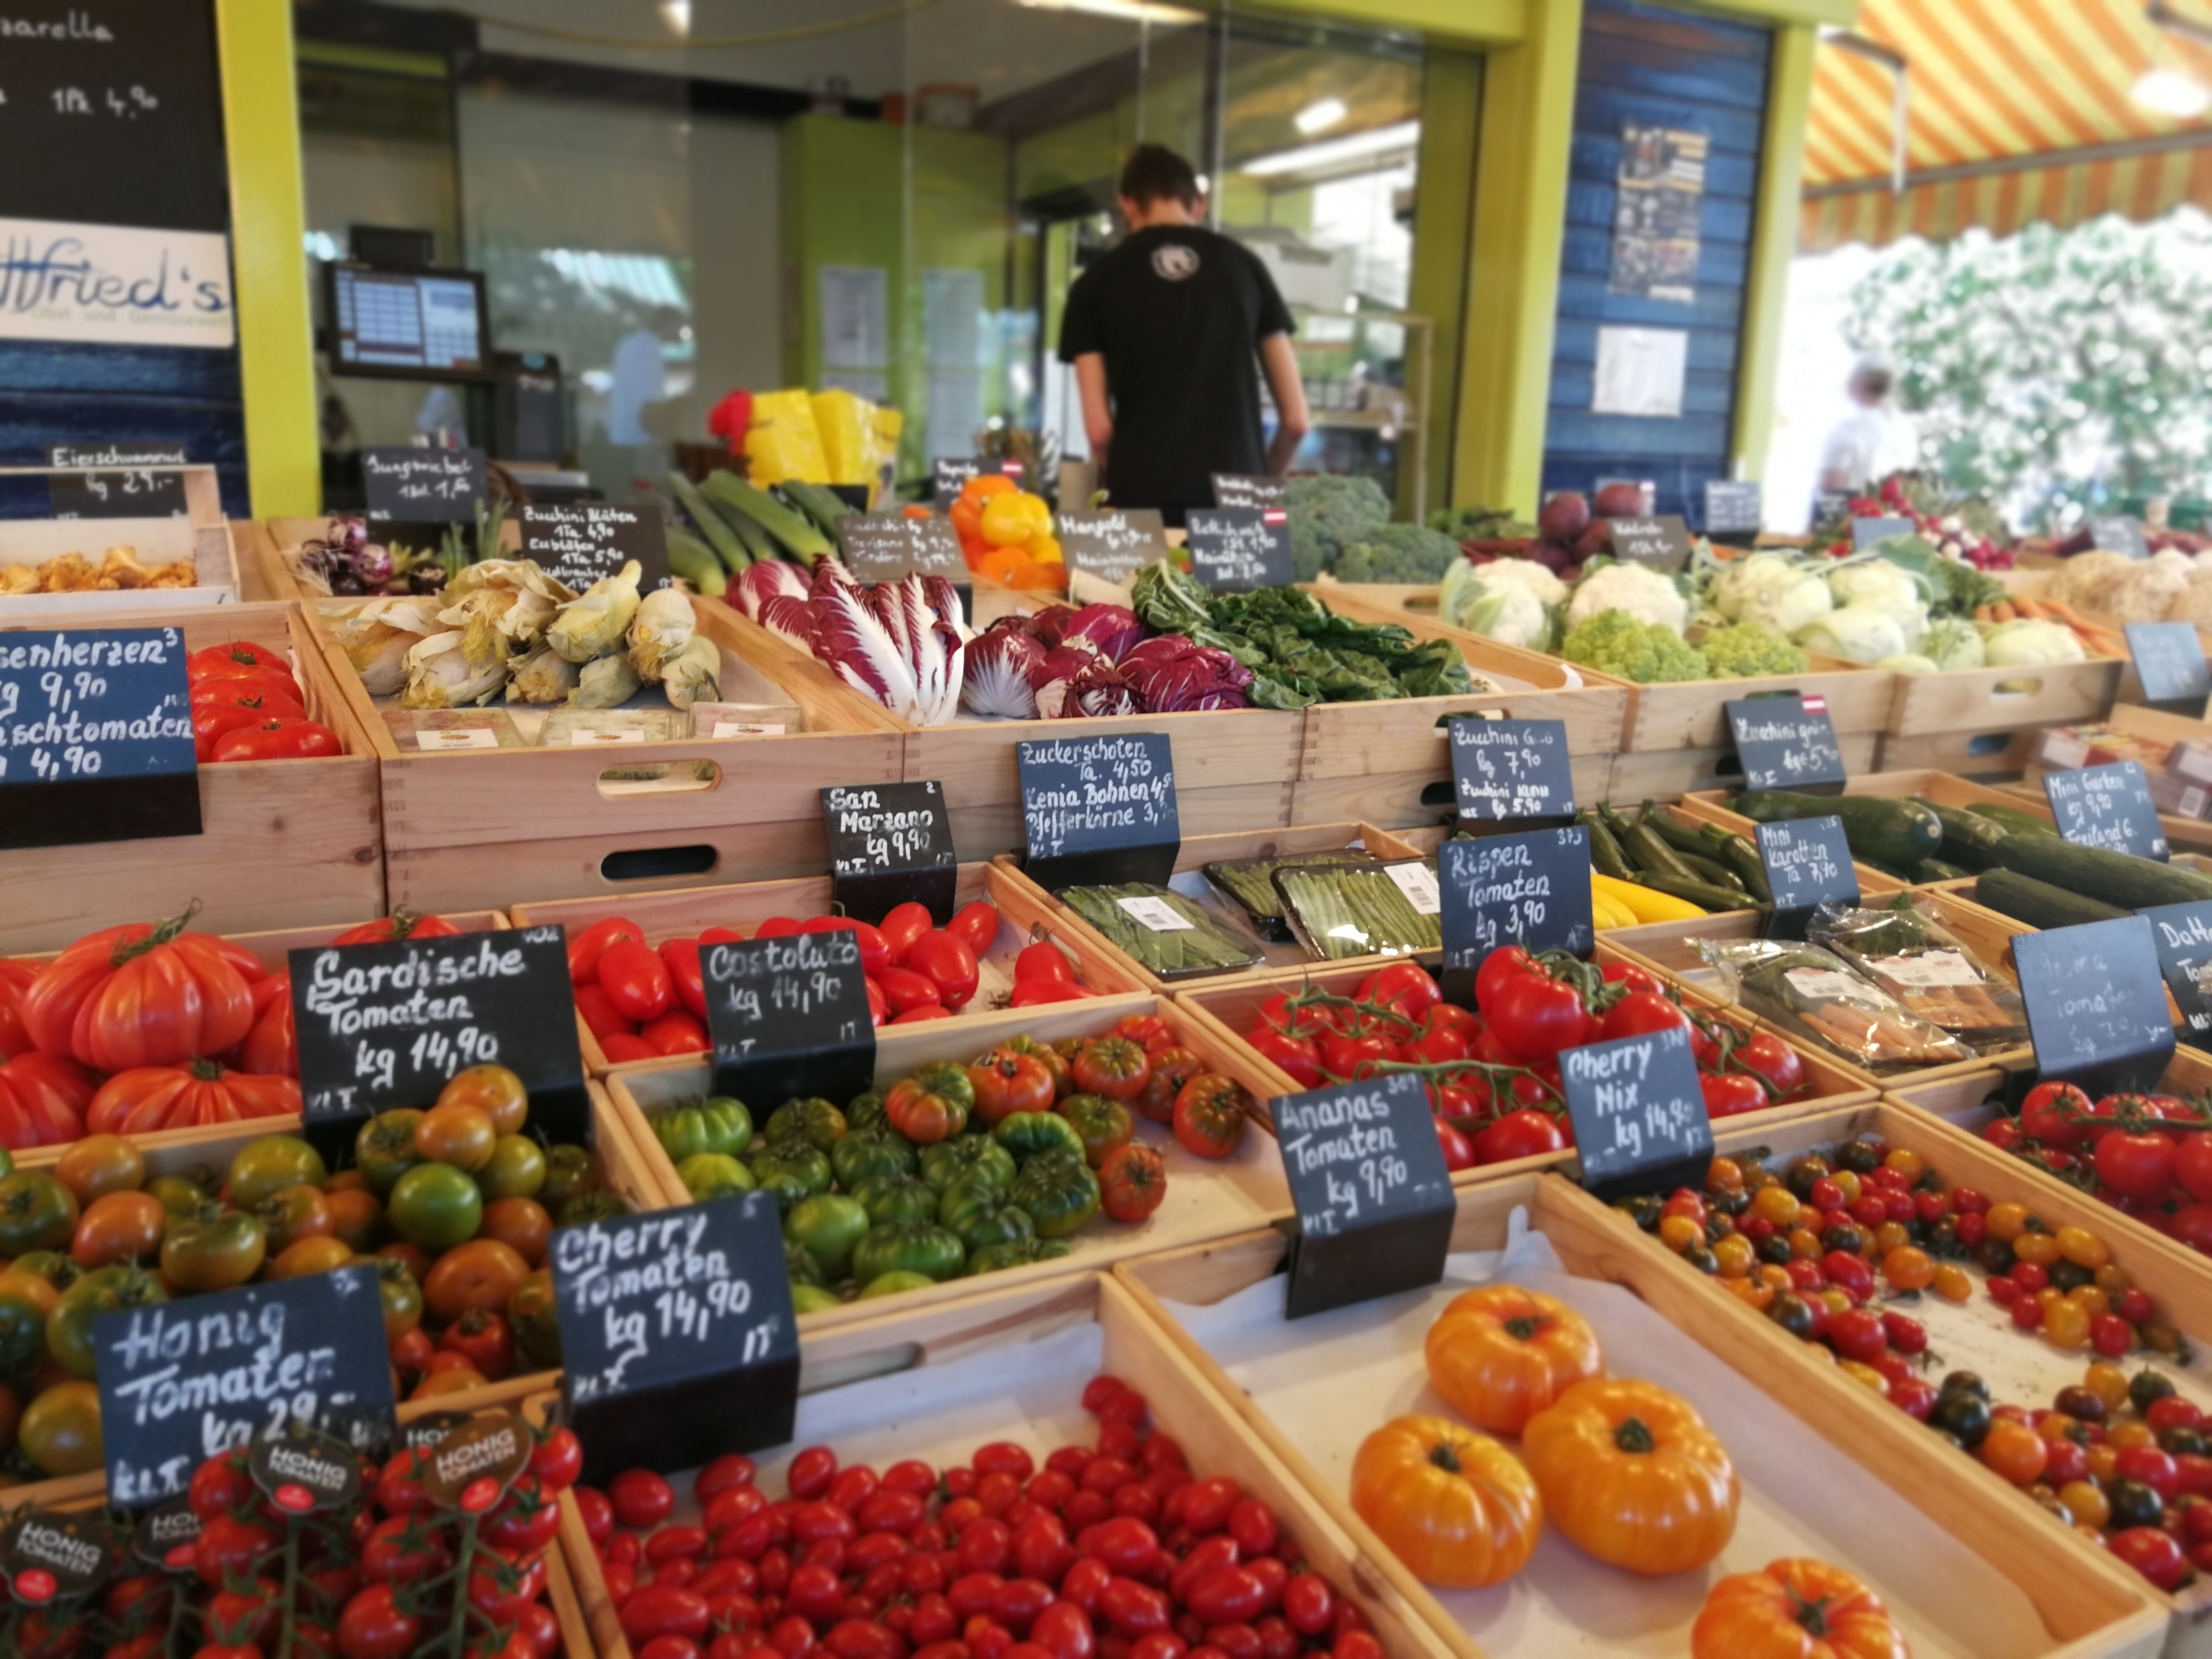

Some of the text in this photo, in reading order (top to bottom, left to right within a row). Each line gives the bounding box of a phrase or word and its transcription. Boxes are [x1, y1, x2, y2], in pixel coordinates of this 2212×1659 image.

[40, 671, 107, 714] 9,90
[30, 745, 102, 782] 4,90
[1112, 758, 1153, 785] 4,50
[1503, 748, 1542, 780] 7,90
[830, 787, 881, 811] San
[1083, 779, 1150, 806] Bohnen
[1512, 798, 1542, 816] 5,90
[840, 809, 934, 834] Marzano
[892, 828, 931, 861] 9,90
[1446, 843, 1533, 880] Rispen
[1458, 869, 1550, 909] Tomaten
[1505, 901, 1546, 943] 3,90
[314, 988, 474, 1036] Tomaten
[730, 971, 842, 1020] kg 14,90
[355, 1026, 499, 1090] kg 14,90
[1567, 1040, 1652, 1084] Cherry
[1280, 1090, 1391, 1132] Ananas
[1594, 1080, 1639, 1118] Mix
[1285, 1122, 1398, 1176] Tomaten
[1614, 1114, 1642, 1158] kg
[1325, 1154, 1408, 1220] kg 9,90
[557, 1212, 708, 1273] Cherry
[571, 1242, 731, 1314] Tomaten
[111, 1291, 287, 1371] Honig
[603, 1279, 752, 1372] kg 14,90
[269, 1445, 347, 1481] HONIG
[436, 1428, 516, 1471] HONIG
[440, 1444, 516, 1483] TOMATEN
[268, 1459, 345, 1492] TOMATEN
[16, 1534, 96, 1575] TOMATEN
[22, 1520, 102, 1563] HONIG
